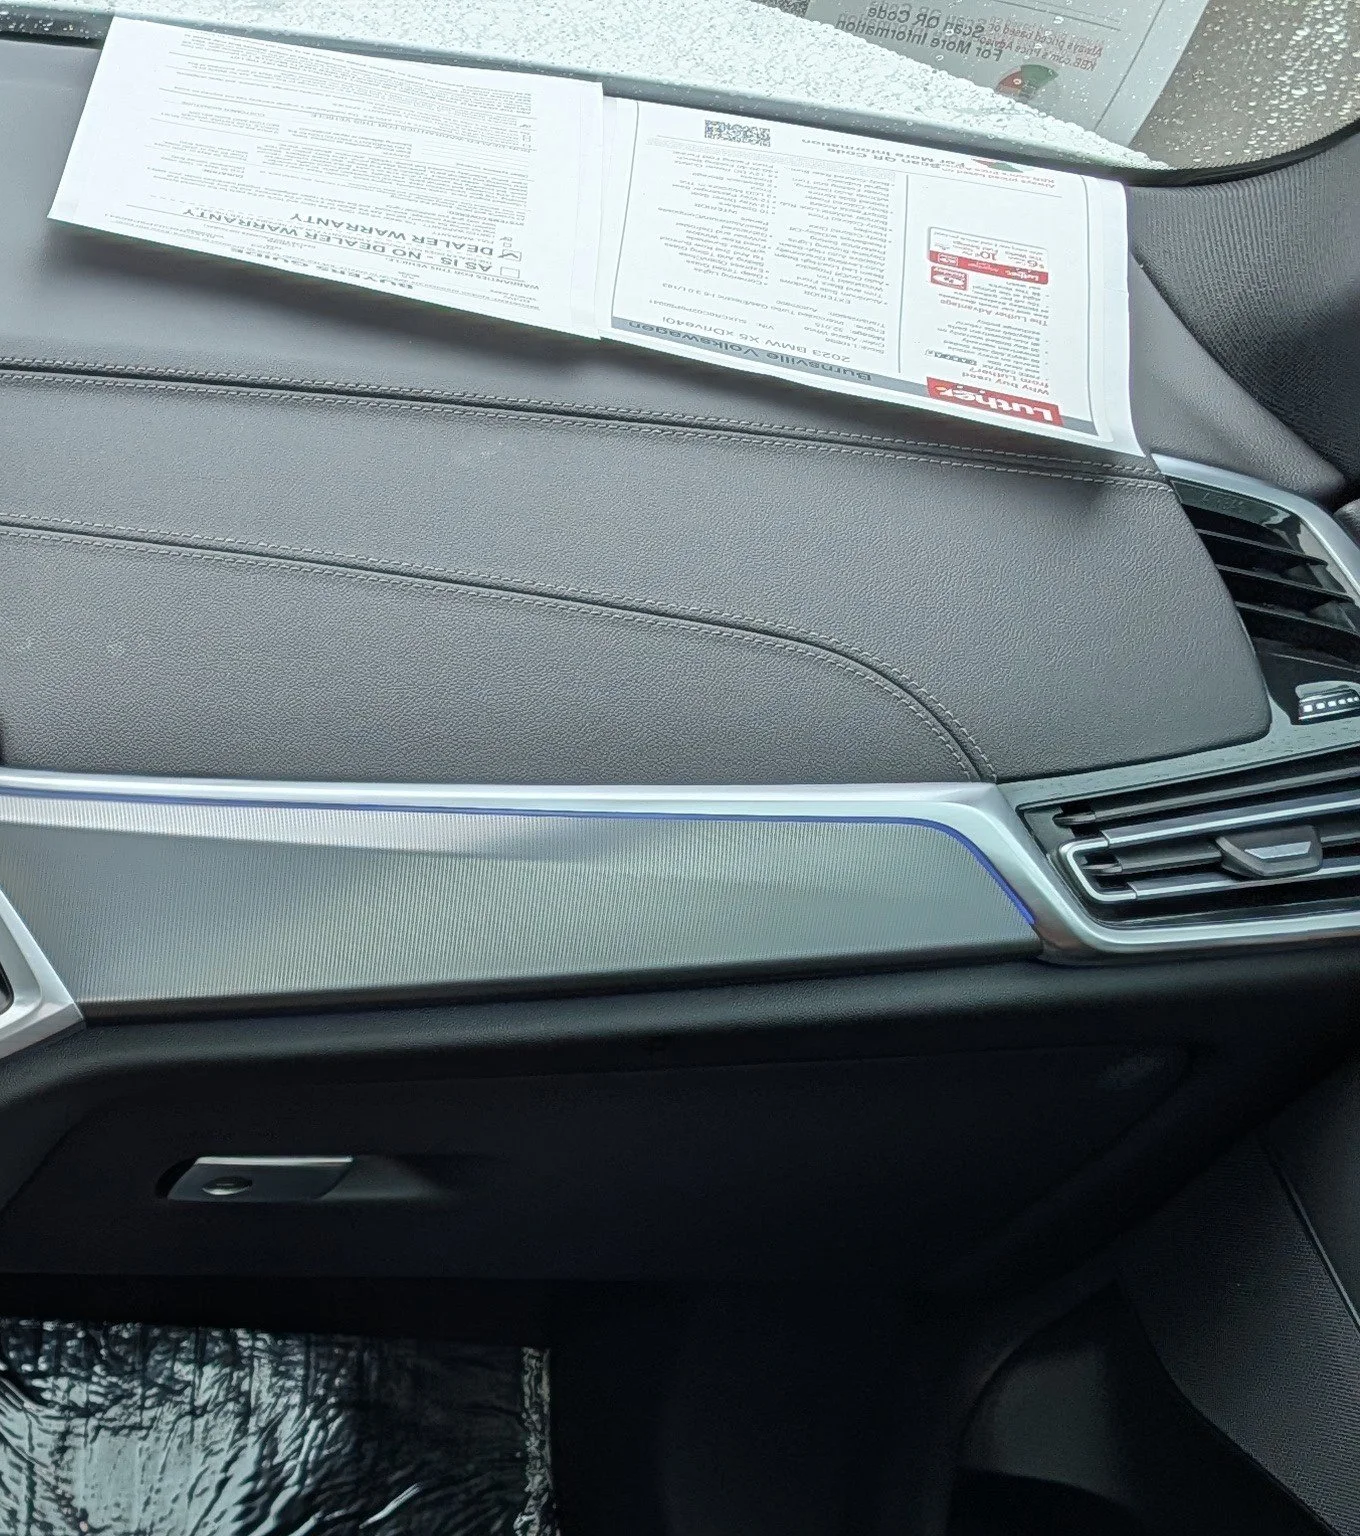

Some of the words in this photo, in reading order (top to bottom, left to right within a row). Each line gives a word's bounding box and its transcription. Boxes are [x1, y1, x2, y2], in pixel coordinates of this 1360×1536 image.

[182, 206, 298, 238] WARRANTY
[289, 209, 406, 243] WARRANTY
[303, 229, 385, 254] DEALER
[391, 247, 421, 260] NO
[410, 231, 493, 258] DEALER
[463, 260, 491, 274] AS
[627, 320, 759, 358] Volkswagen
[764, 338, 807, 354] BMW
[765, 351, 871, 382] Burnsville
[811, 348, 850, 363] 2023
[938, 385, 1052, 421] Luther
